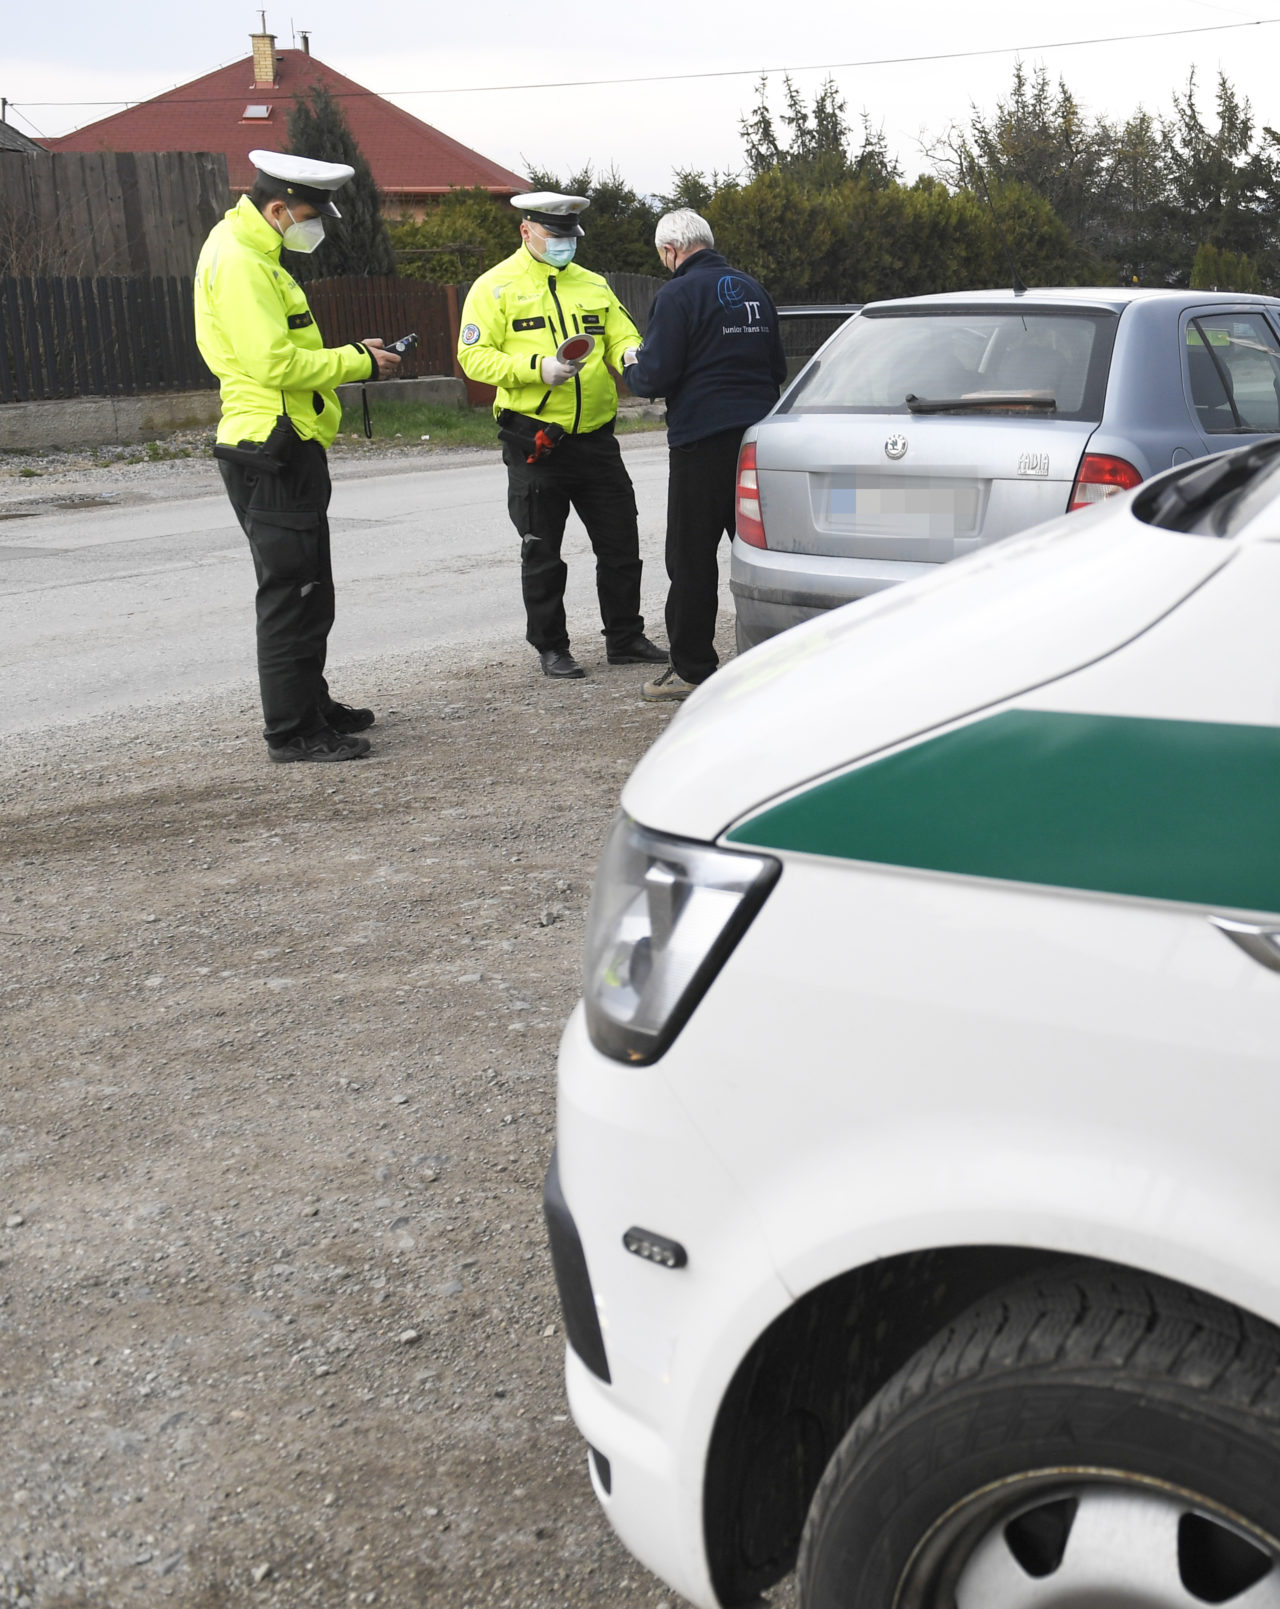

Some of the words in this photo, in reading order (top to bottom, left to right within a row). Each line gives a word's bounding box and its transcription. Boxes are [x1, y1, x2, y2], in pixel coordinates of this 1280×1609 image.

[744, 301, 760, 324] JT
[722, 325, 742, 335] Junior
[743, 325, 760, 333] Trans
